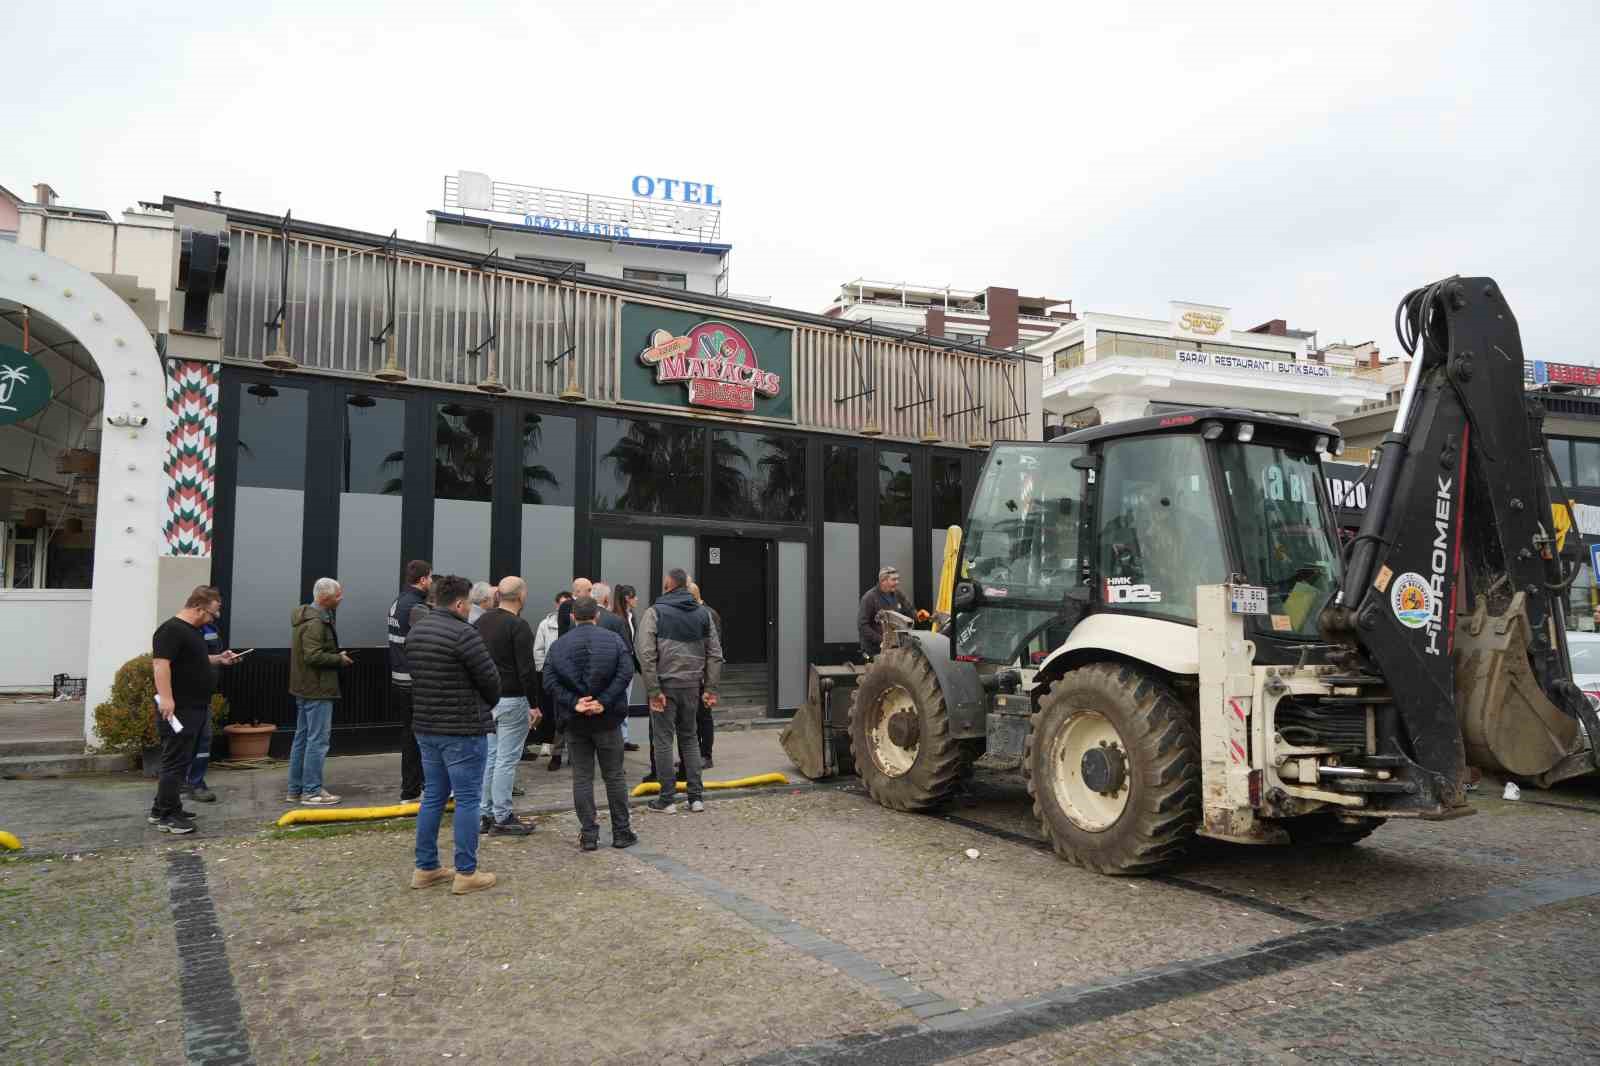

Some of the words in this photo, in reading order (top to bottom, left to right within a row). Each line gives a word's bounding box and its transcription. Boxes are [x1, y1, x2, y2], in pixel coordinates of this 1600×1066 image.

[632, 175, 721, 207] OTEL
[657, 352, 780, 395] MARACAS
[1179, 352, 1207, 364] SARAY
[1215, 356, 1270, 371] RESTAURANT
[1303, 366, 1329, 377] SALON
[1107, 576, 1132, 585] HMK
